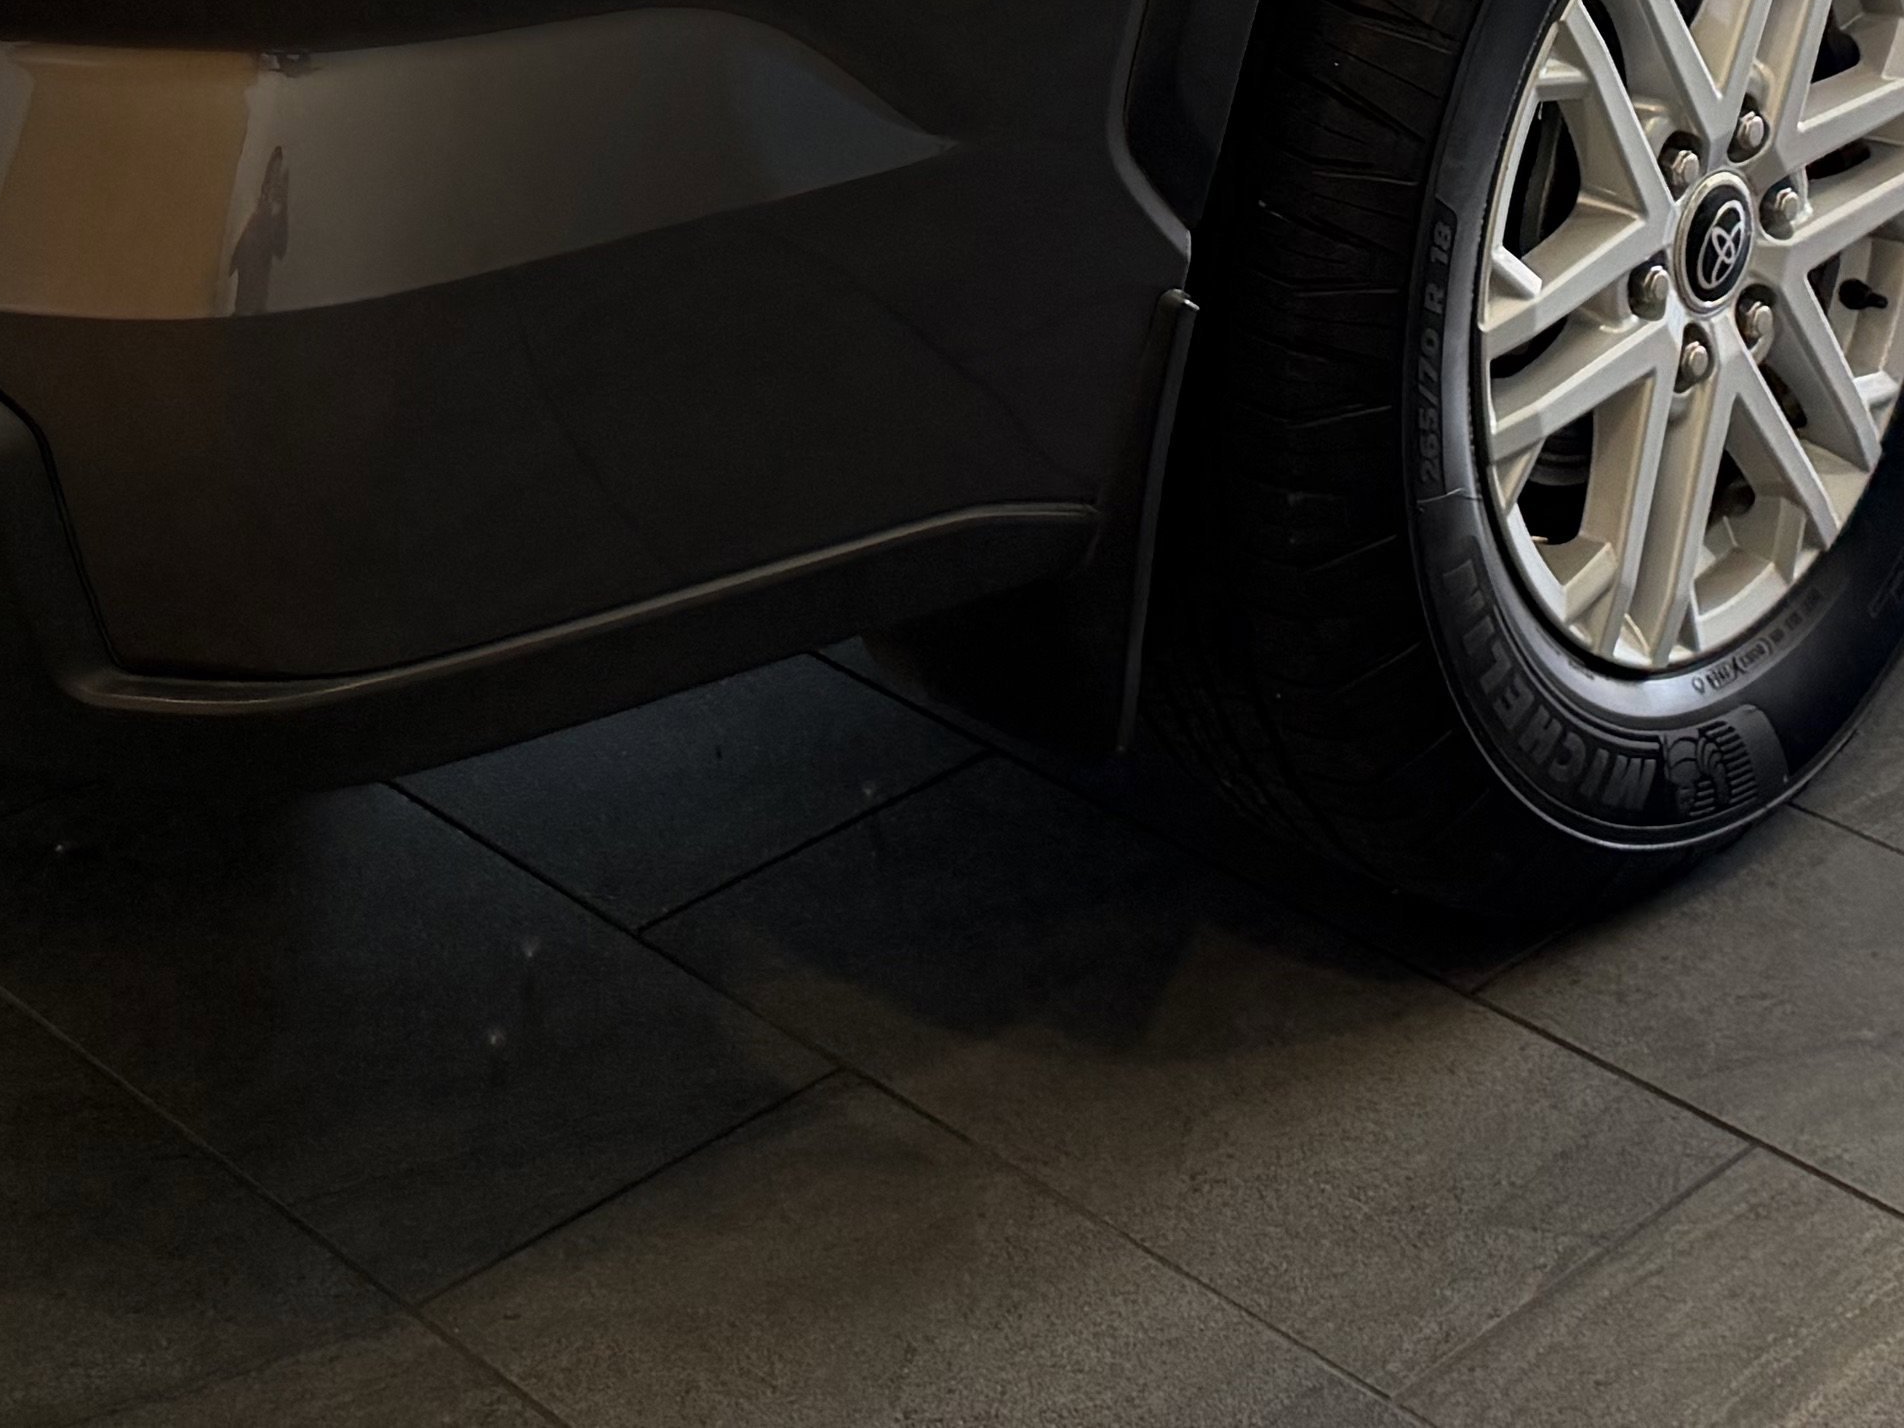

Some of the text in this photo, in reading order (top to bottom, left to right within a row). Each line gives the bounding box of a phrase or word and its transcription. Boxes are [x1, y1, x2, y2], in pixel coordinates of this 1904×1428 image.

[1417, 221, 1452, 485] 265/70 R 18
[1441, 557, 1658, 812] MICHELIN
